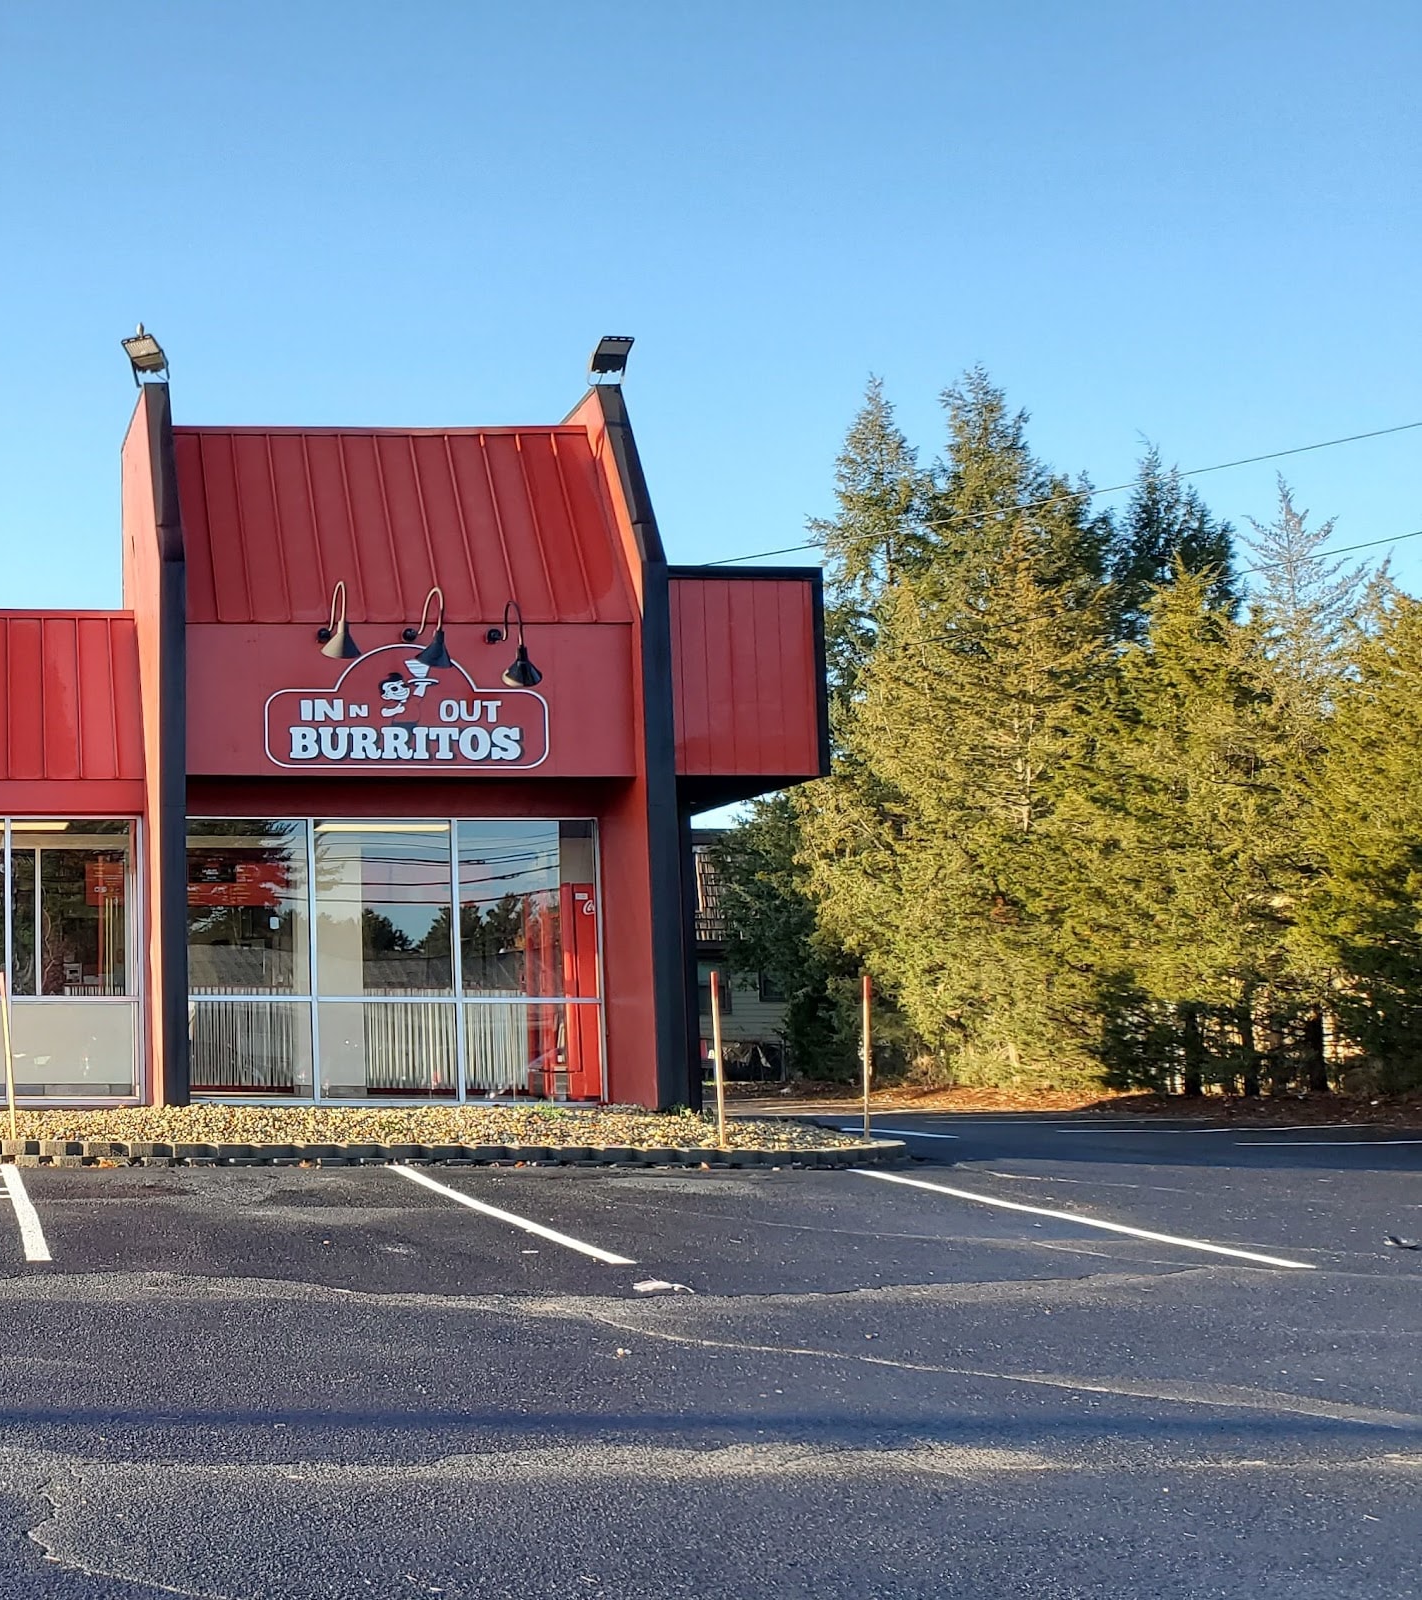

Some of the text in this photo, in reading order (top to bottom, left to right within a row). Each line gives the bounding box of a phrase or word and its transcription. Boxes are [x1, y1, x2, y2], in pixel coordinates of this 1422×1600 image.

[299, 699, 345, 722] IN
[439, 699, 502, 723] OUT
[289, 726, 522, 761] BURRITOS
